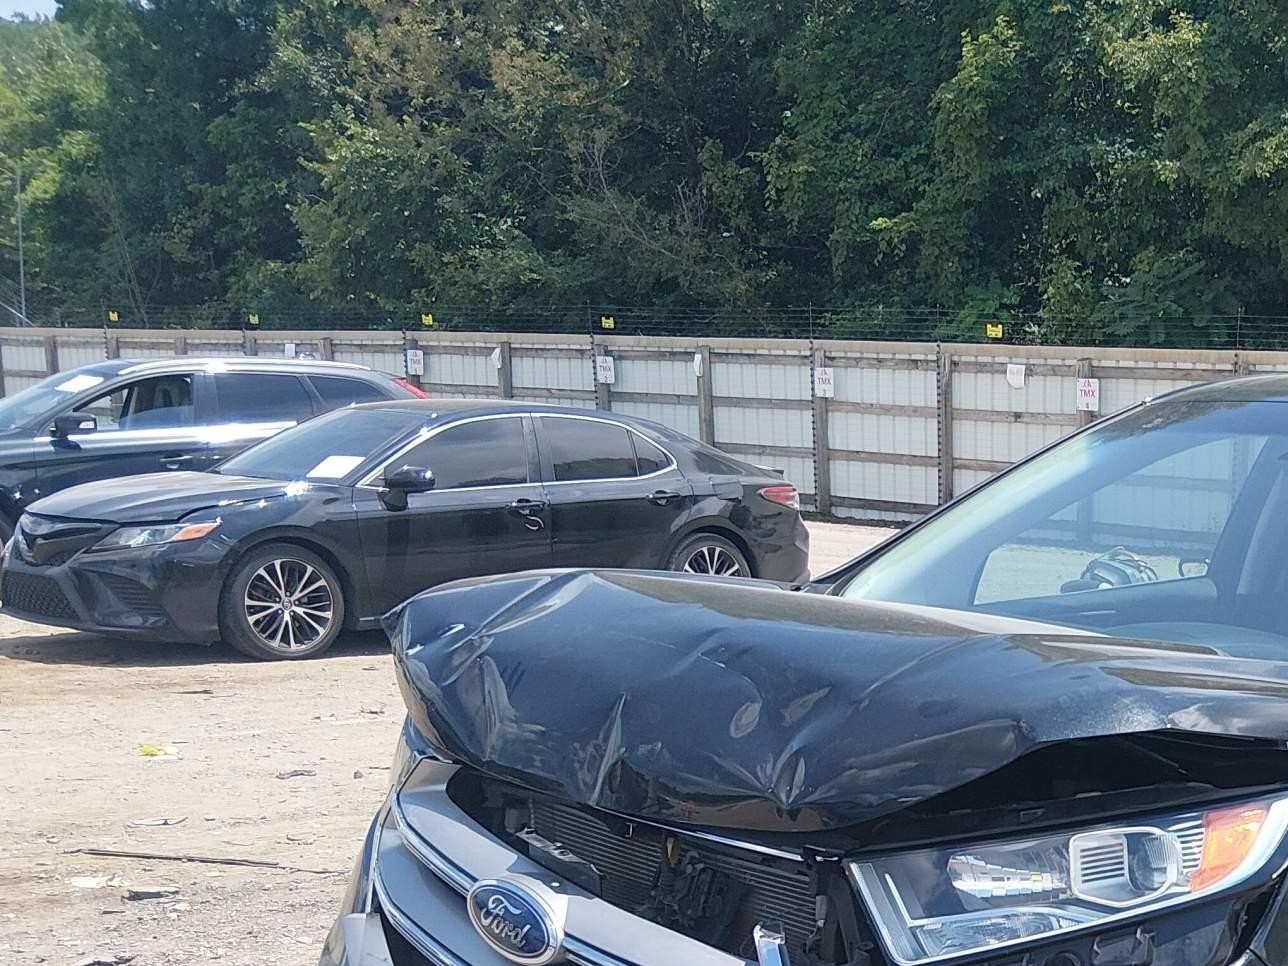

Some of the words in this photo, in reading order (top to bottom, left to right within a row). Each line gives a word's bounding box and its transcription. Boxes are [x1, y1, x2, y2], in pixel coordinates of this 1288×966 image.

[818, 377, 832, 385] TMX
[1080, 389, 1096, 398] TMX
[480, 894, 531, 948] Ford
